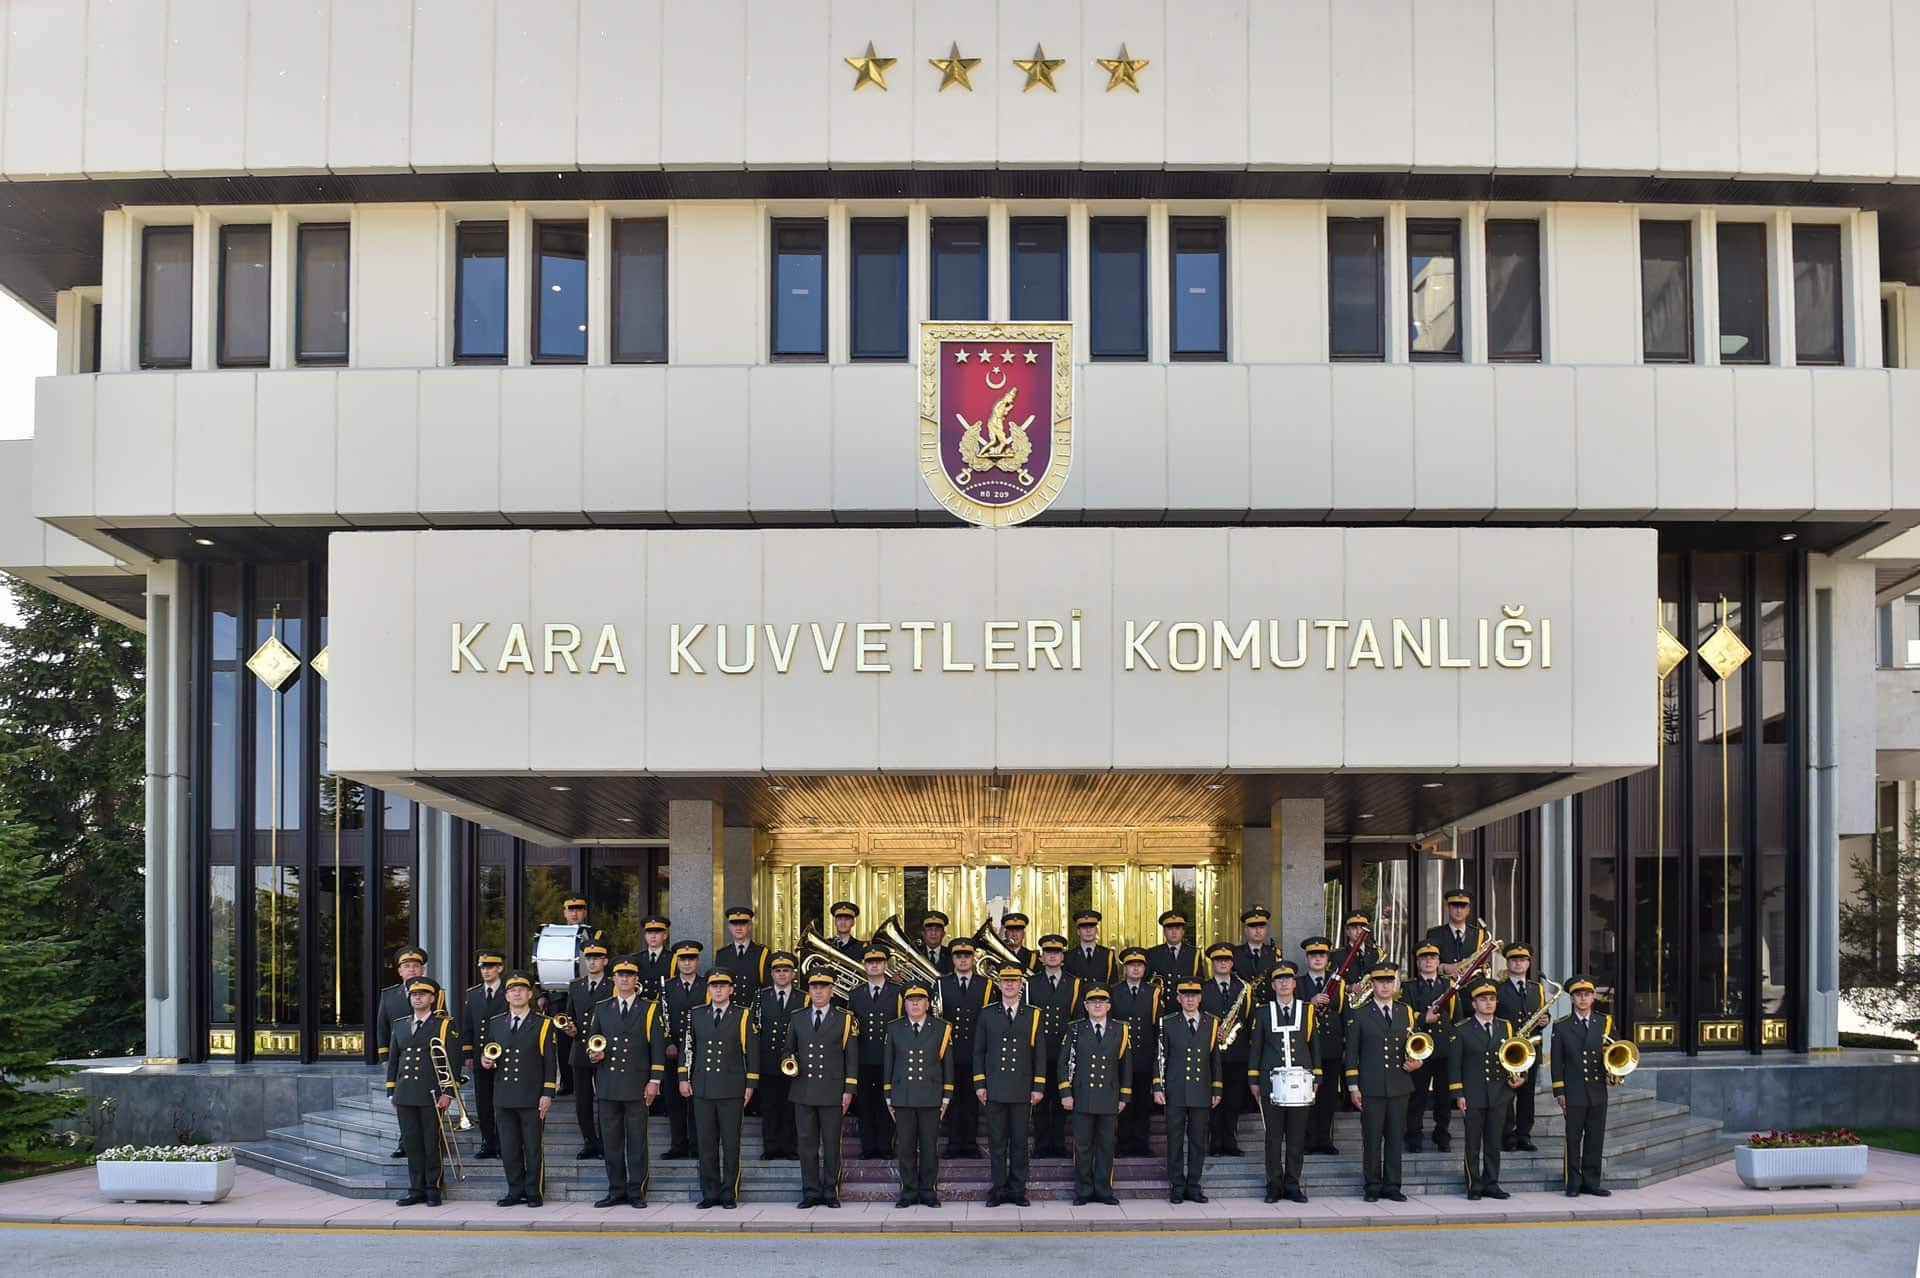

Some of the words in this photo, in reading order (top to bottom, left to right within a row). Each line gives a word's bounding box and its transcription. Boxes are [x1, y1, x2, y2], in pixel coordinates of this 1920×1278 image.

[450, 622, 628, 674] KARA
[669, 608, 1082, 675] KUVVETLERİ
[1124, 604, 1553, 672] KOMUTANLIĞI
